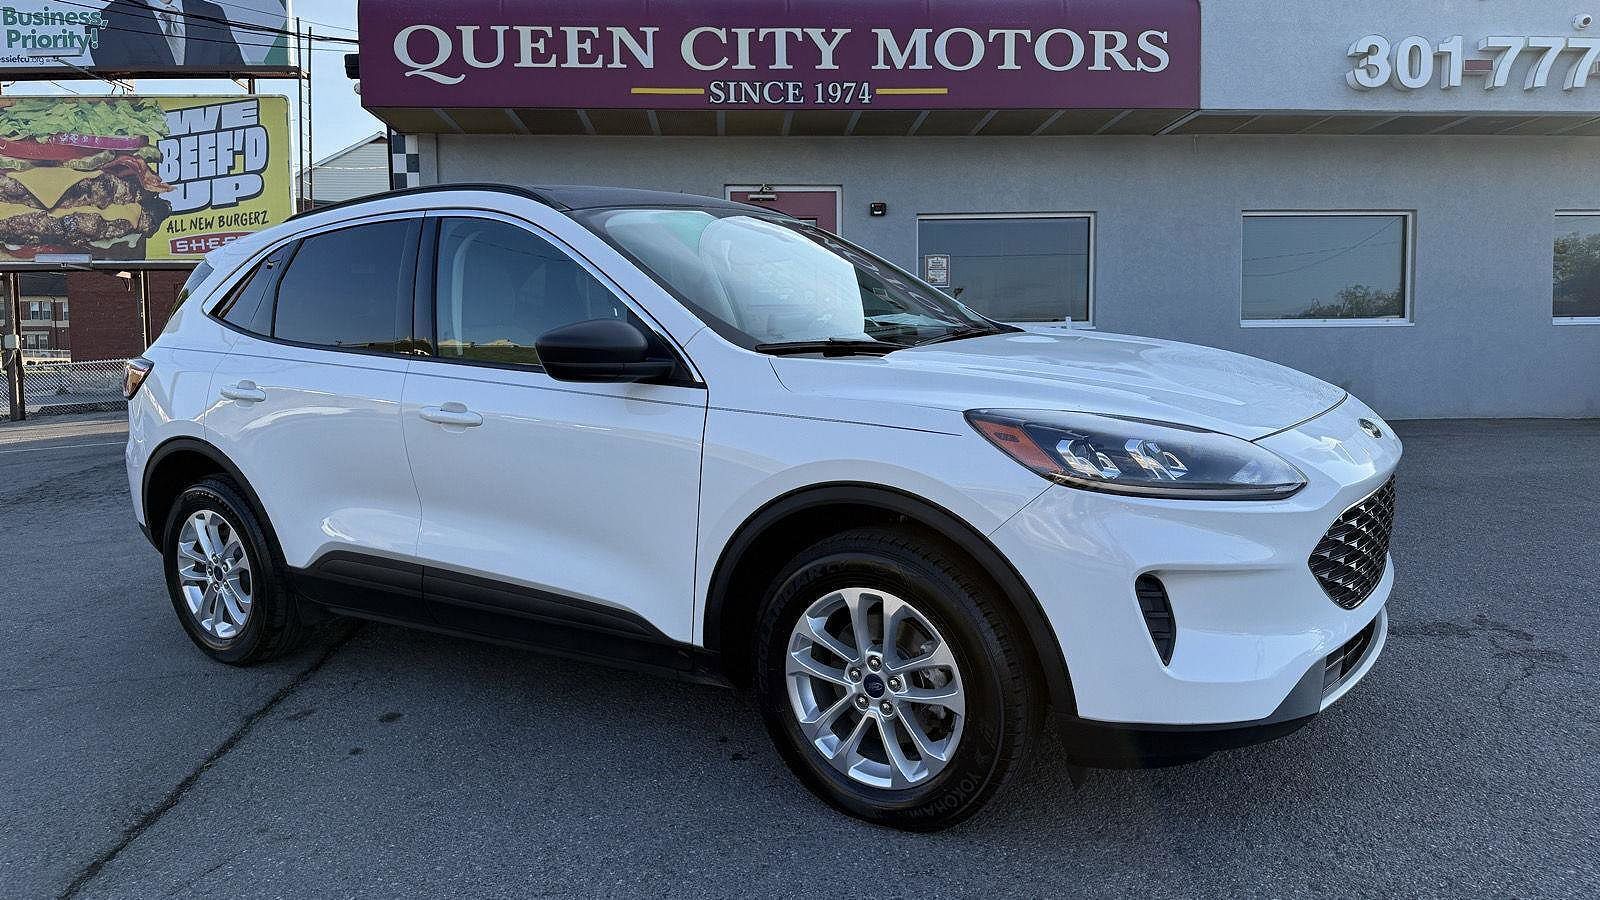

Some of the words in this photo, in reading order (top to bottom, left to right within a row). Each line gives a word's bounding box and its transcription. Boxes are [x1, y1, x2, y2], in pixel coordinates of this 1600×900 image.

[3, 6, 108, 29] Business,
[7, 28, 99, 54] Priority!
[393, 24, 659, 85] QUEEN
[680, 27, 852, 72] CITY
[871, 28, 1170, 73] MOTORS
[709, 80, 804, 104] SINCE
[814, 81, 873, 104] 1974
[164, 98, 260, 137] WE
[157, 127, 269, 185] BEEF'D
[159, 173, 264, 214] UP
[166, 219, 186, 233] ALL
[189, 216, 215, 231] NEW
[218, 210, 269, 228] BURGERZ
